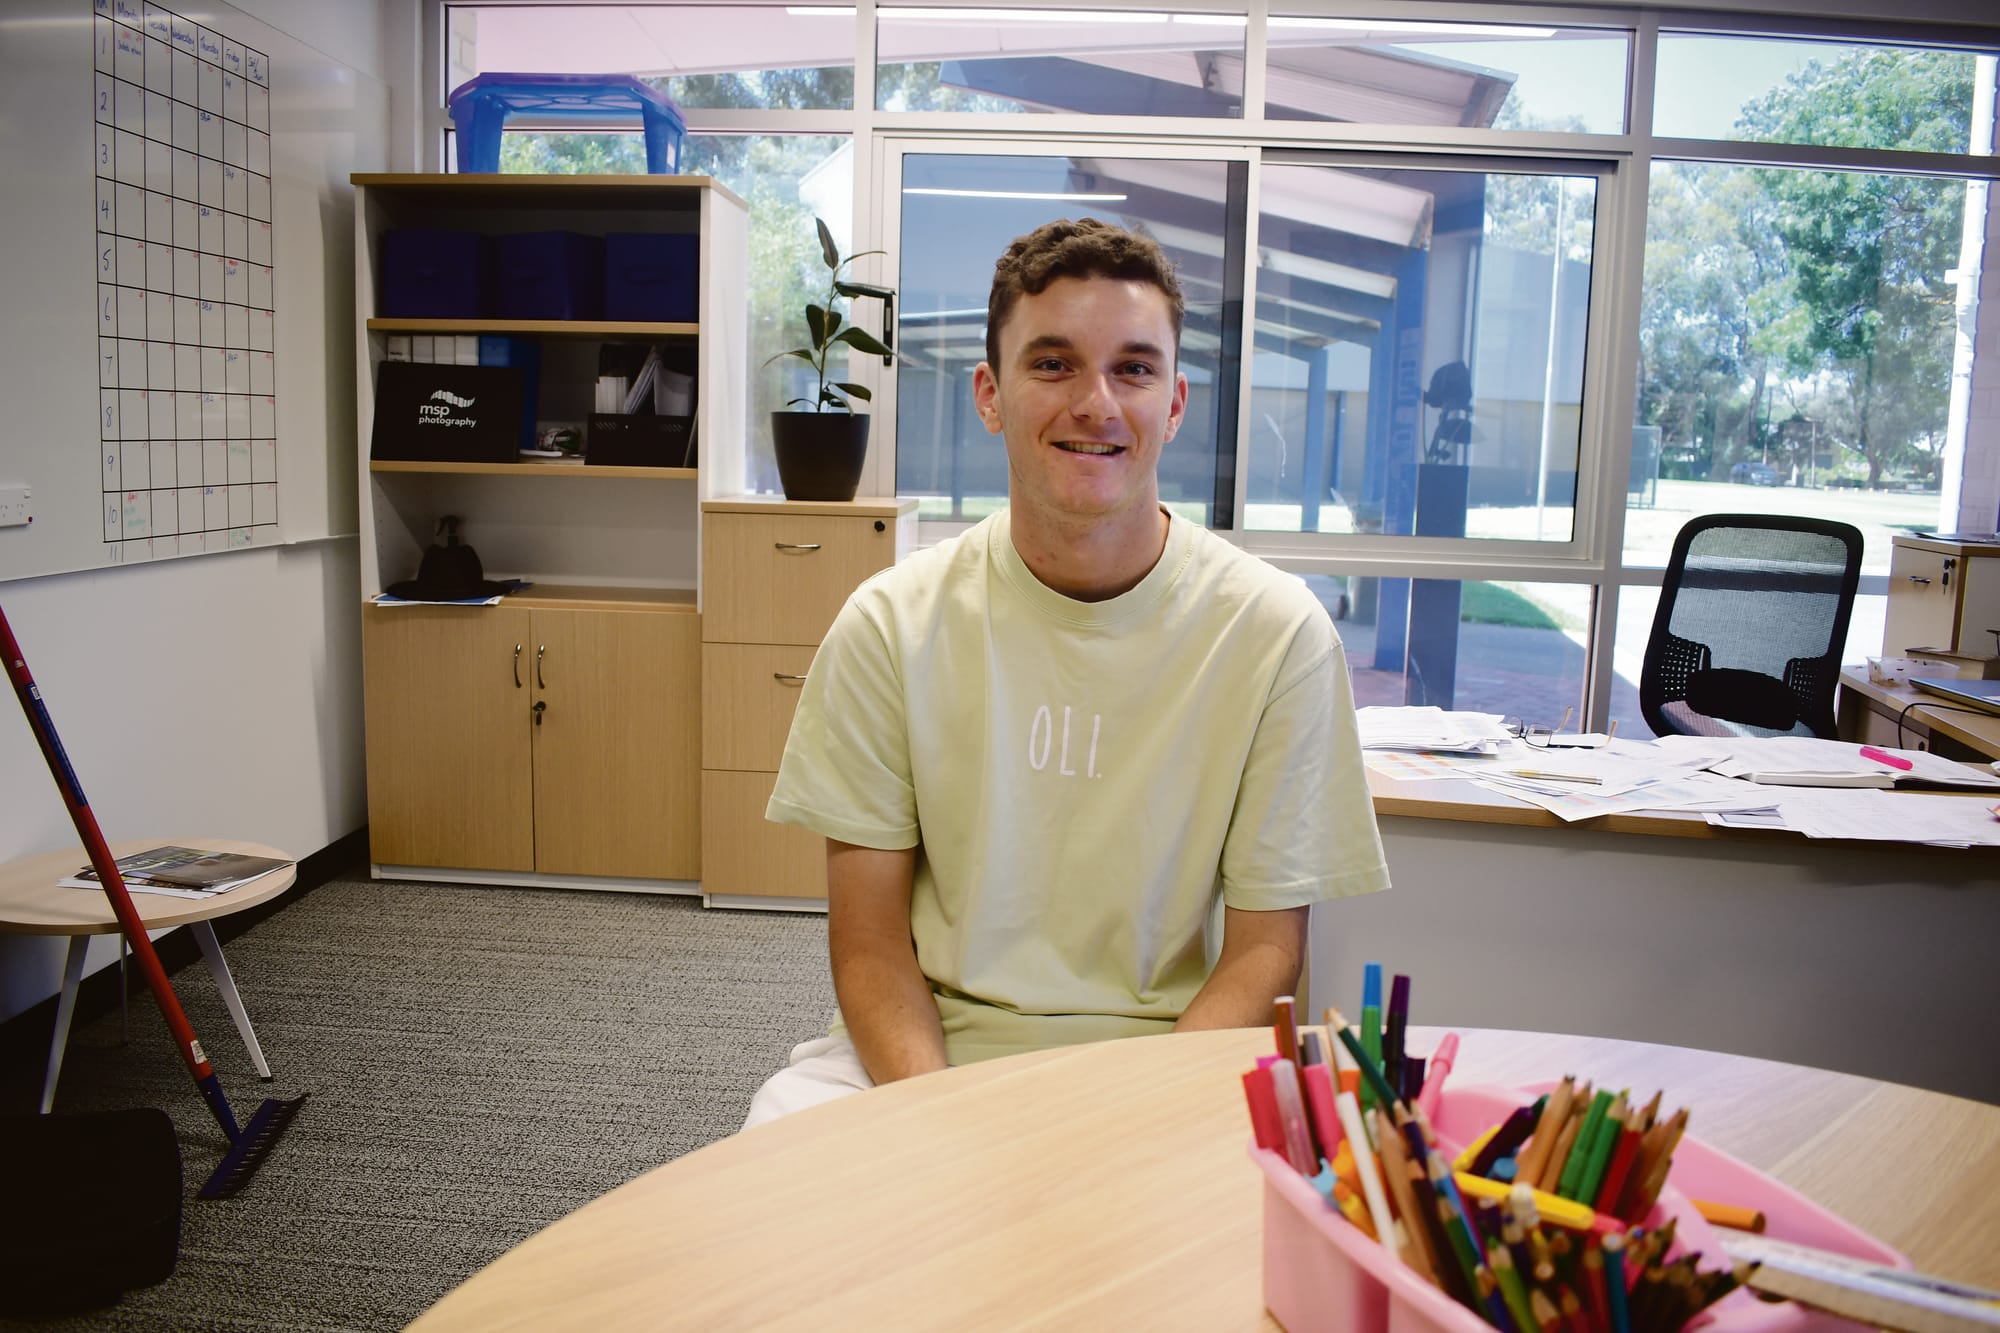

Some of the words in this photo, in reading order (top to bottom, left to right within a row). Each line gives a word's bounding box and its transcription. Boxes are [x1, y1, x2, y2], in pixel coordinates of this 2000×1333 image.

[226, 48, 240, 71] Friday
[100, 91, 107, 111] 2
[102, 143, 108, 164] 3
[101, 199, 109, 220] 4
[102, 248, 111, 271] 5
[104, 297, 111, 321] 6
[105, 356, 113, 374] 7
[106, 406, 113, 428] 8
[420, 404, 450, 418] msp
[418, 415, 477, 428] photography
[107, 455, 114, 471] 9
[108, 504, 118, 524] 10
